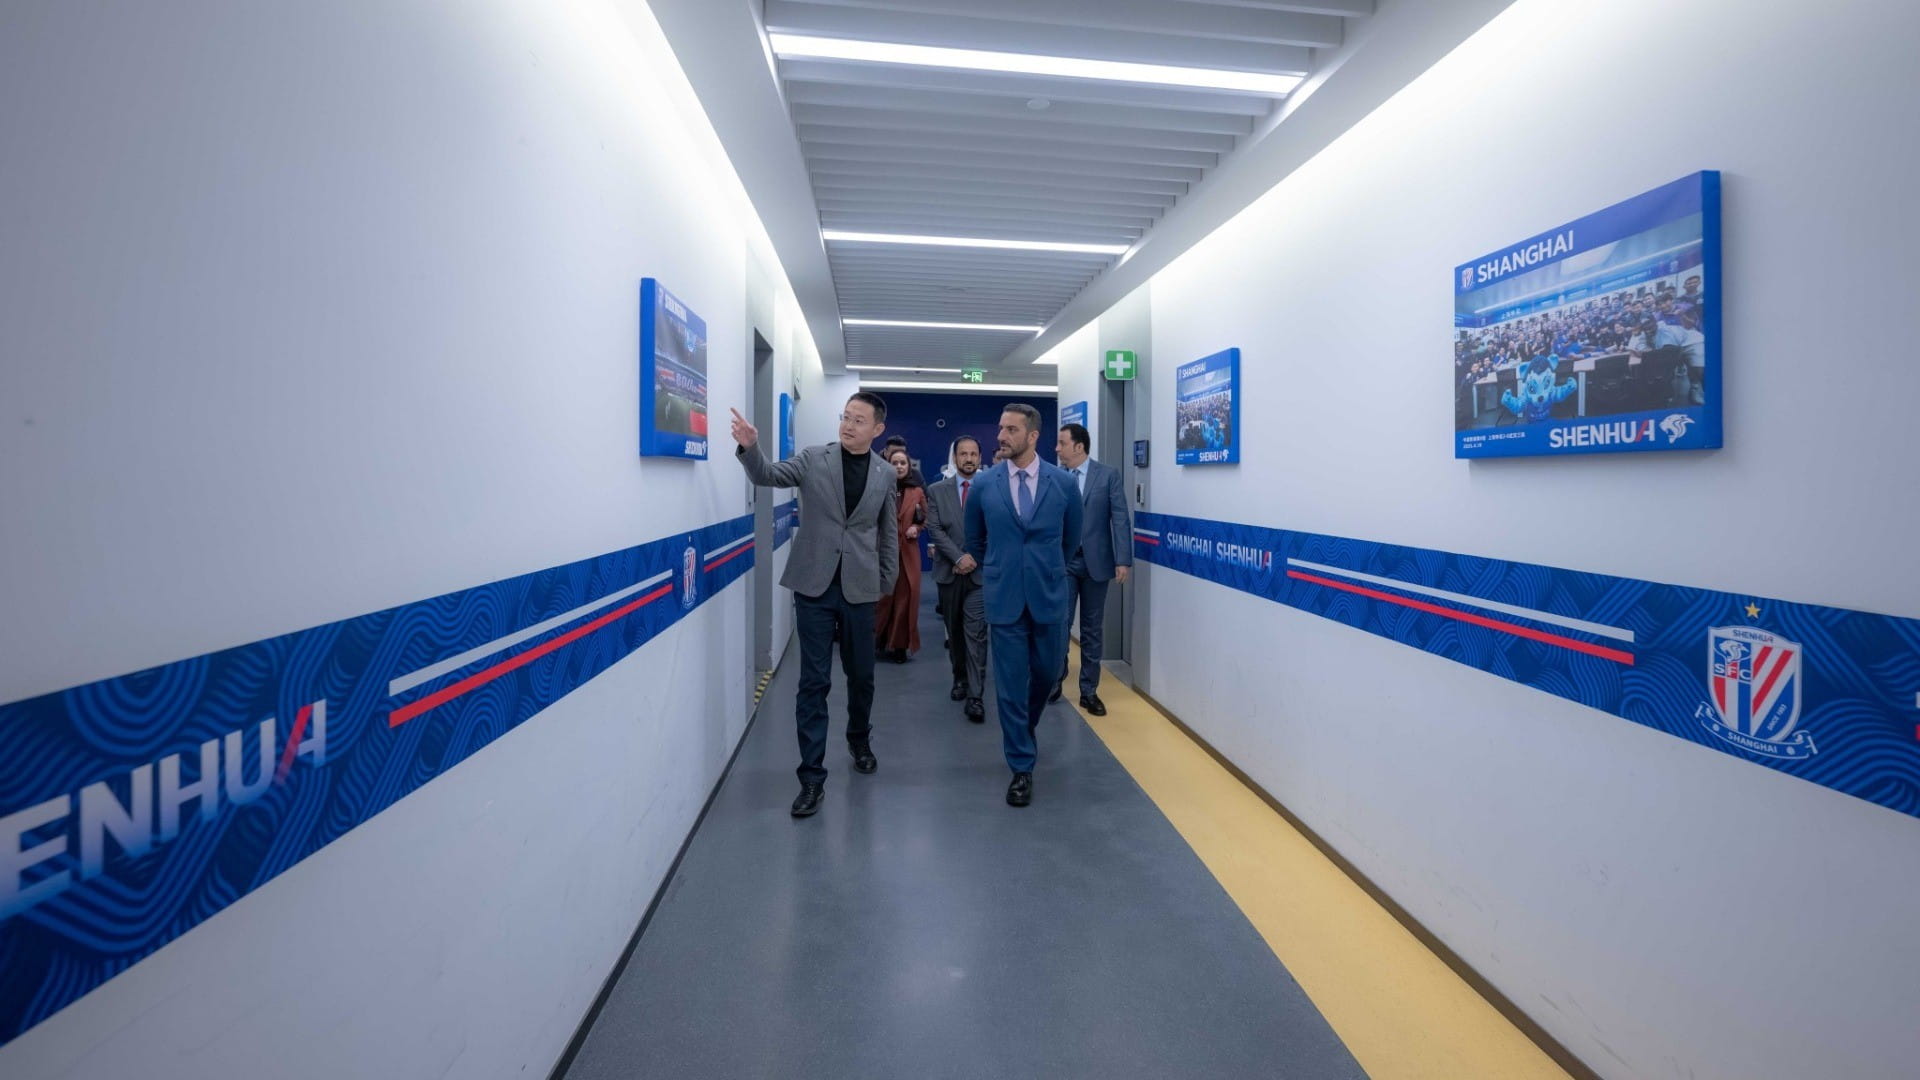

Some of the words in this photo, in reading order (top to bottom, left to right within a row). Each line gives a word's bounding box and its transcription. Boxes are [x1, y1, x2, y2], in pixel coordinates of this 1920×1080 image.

[1477, 230, 1574, 283] SHANGHAI
[1550, 419, 1656, 448] SHENHUA
[1167, 532, 1212, 558] SHANGHAI
[1217, 542, 1272, 573] SHENHUA
[1727, 732, 1778, 754] SHANGHAI
